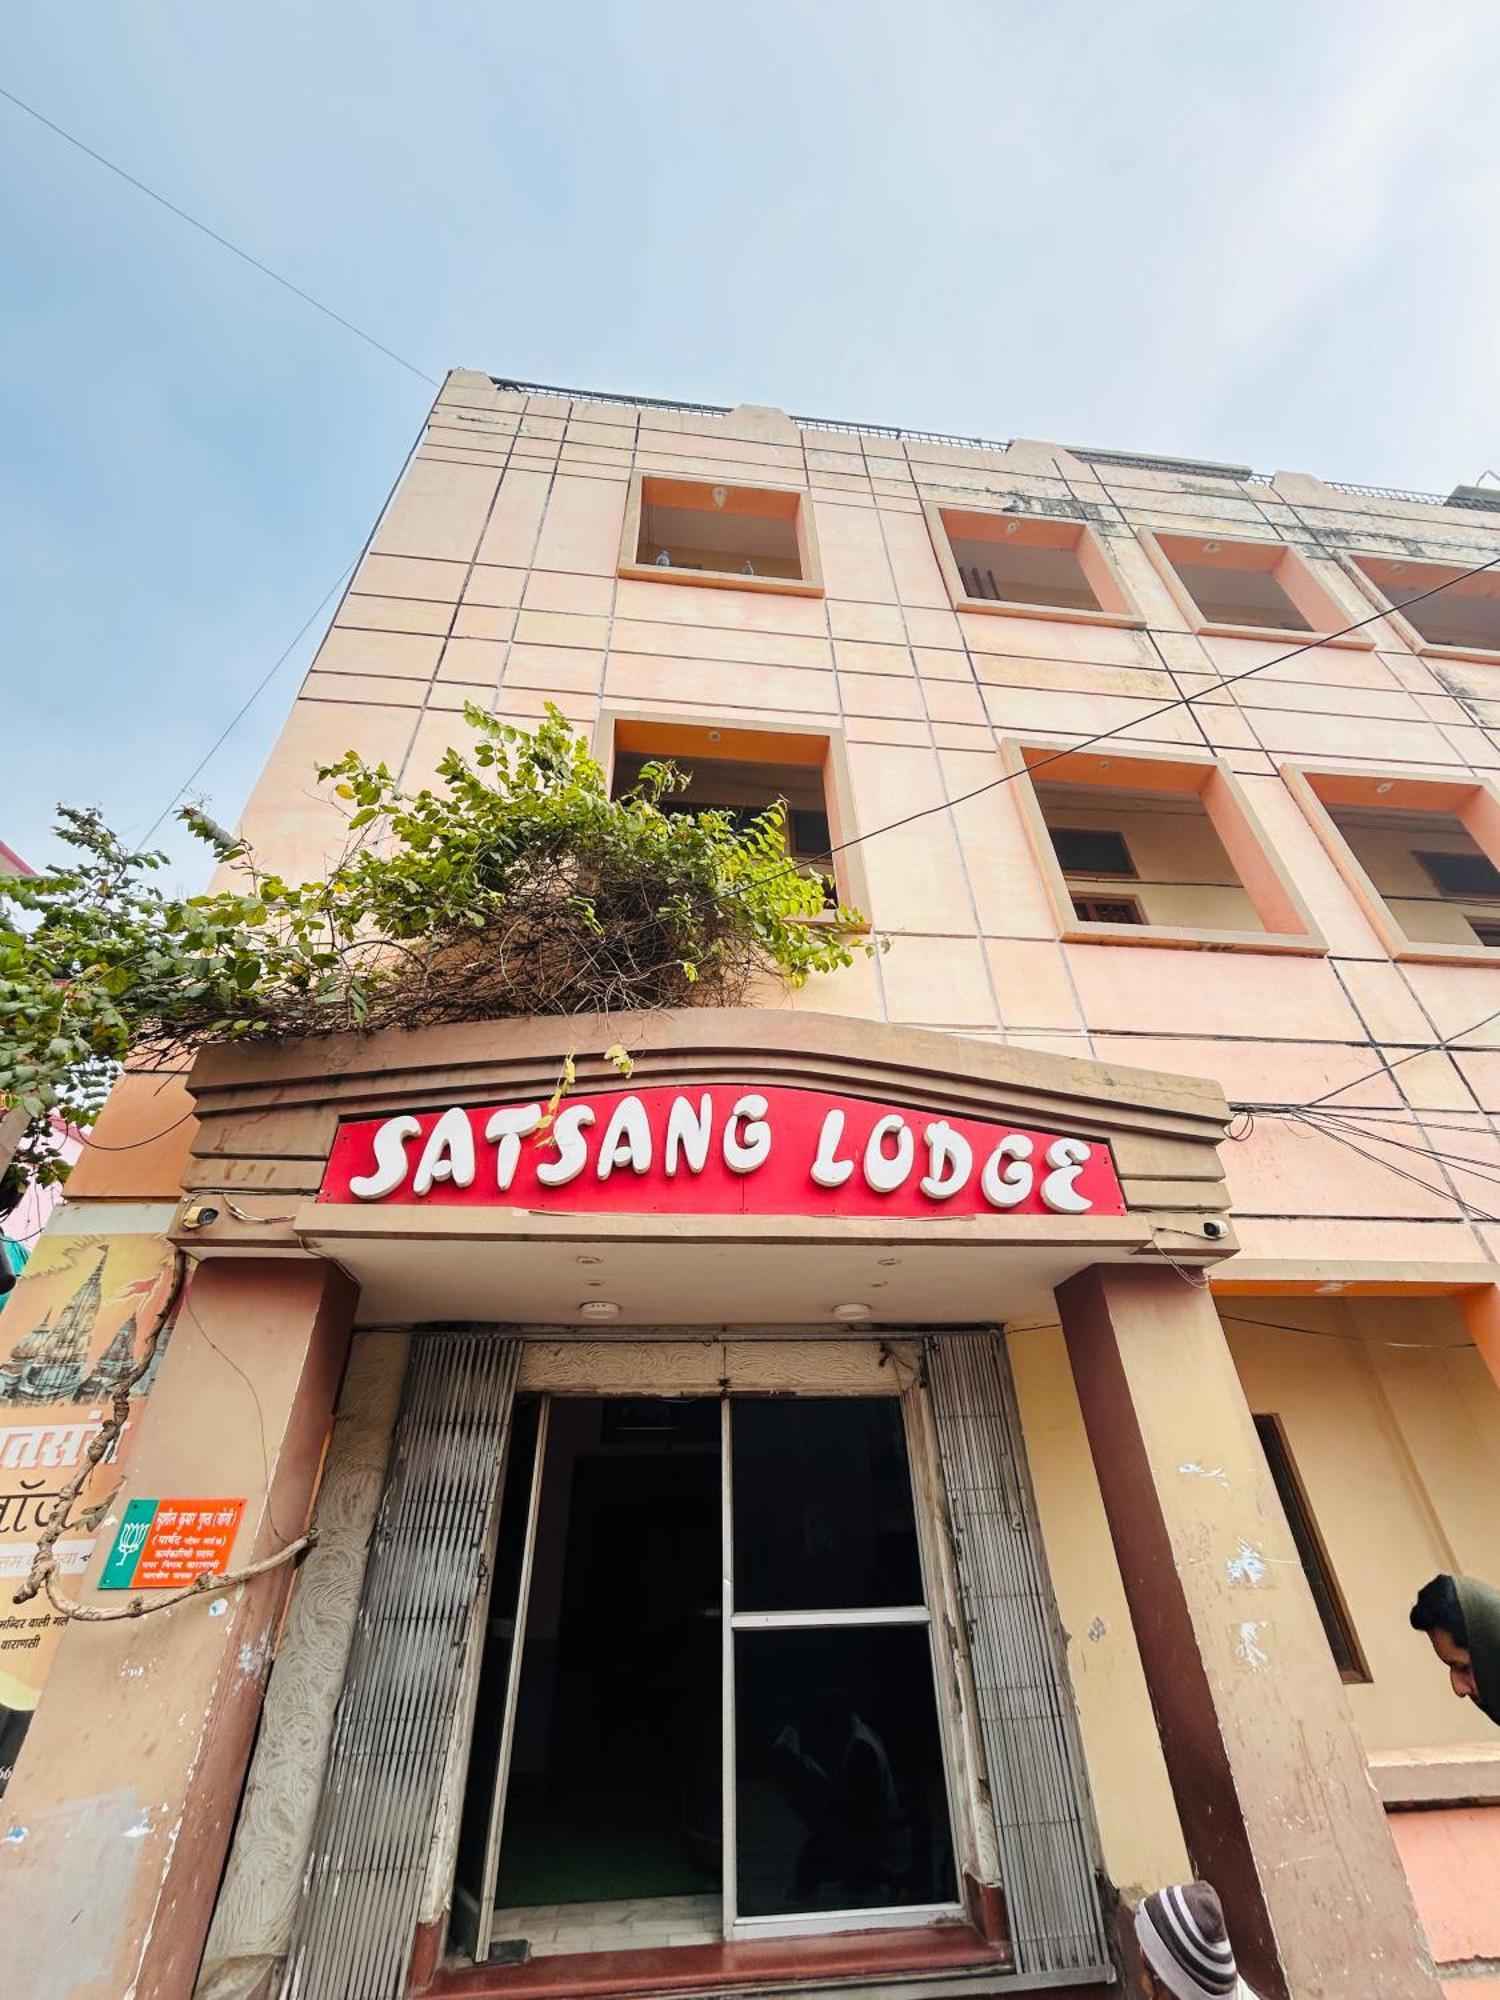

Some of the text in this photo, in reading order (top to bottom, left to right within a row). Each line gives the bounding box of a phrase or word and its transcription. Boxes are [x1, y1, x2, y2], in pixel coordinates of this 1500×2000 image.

[350, 1092, 1093, 1214] SATSANG LODGE
[1, 1634, 40, 1649] वाराणसी
